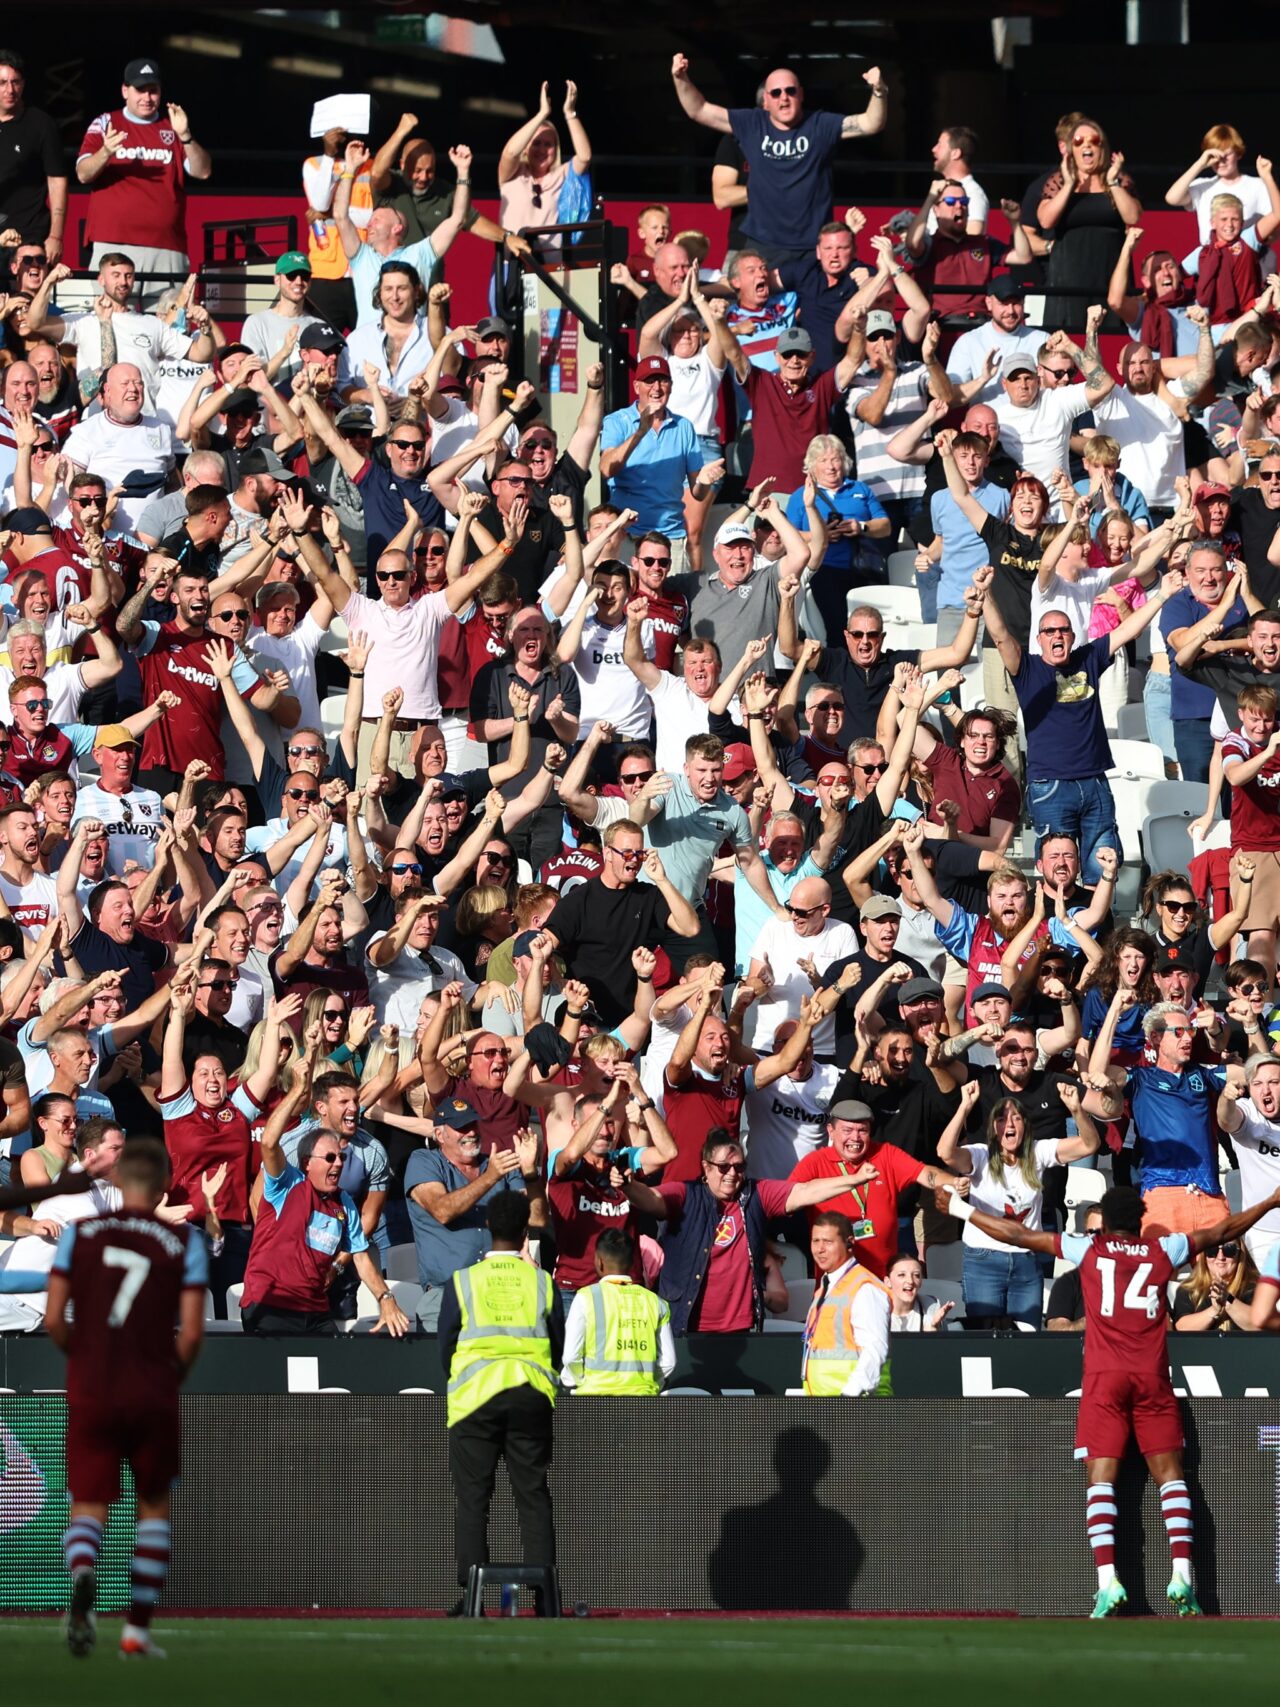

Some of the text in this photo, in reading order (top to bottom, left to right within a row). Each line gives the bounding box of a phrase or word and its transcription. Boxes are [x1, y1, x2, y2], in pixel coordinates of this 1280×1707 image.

[115, 145, 173, 165] betway
[168, 657, 220, 692] betway
[106, 820, 158, 838] etway
[548, 855, 600, 872] LANZINI
[15, 908, 48, 922] evi's
[102, 1245, 151, 1328] 7
[1096, 1256, 1159, 1319] 14
[618, 1319, 648, 1329] SAFETY
